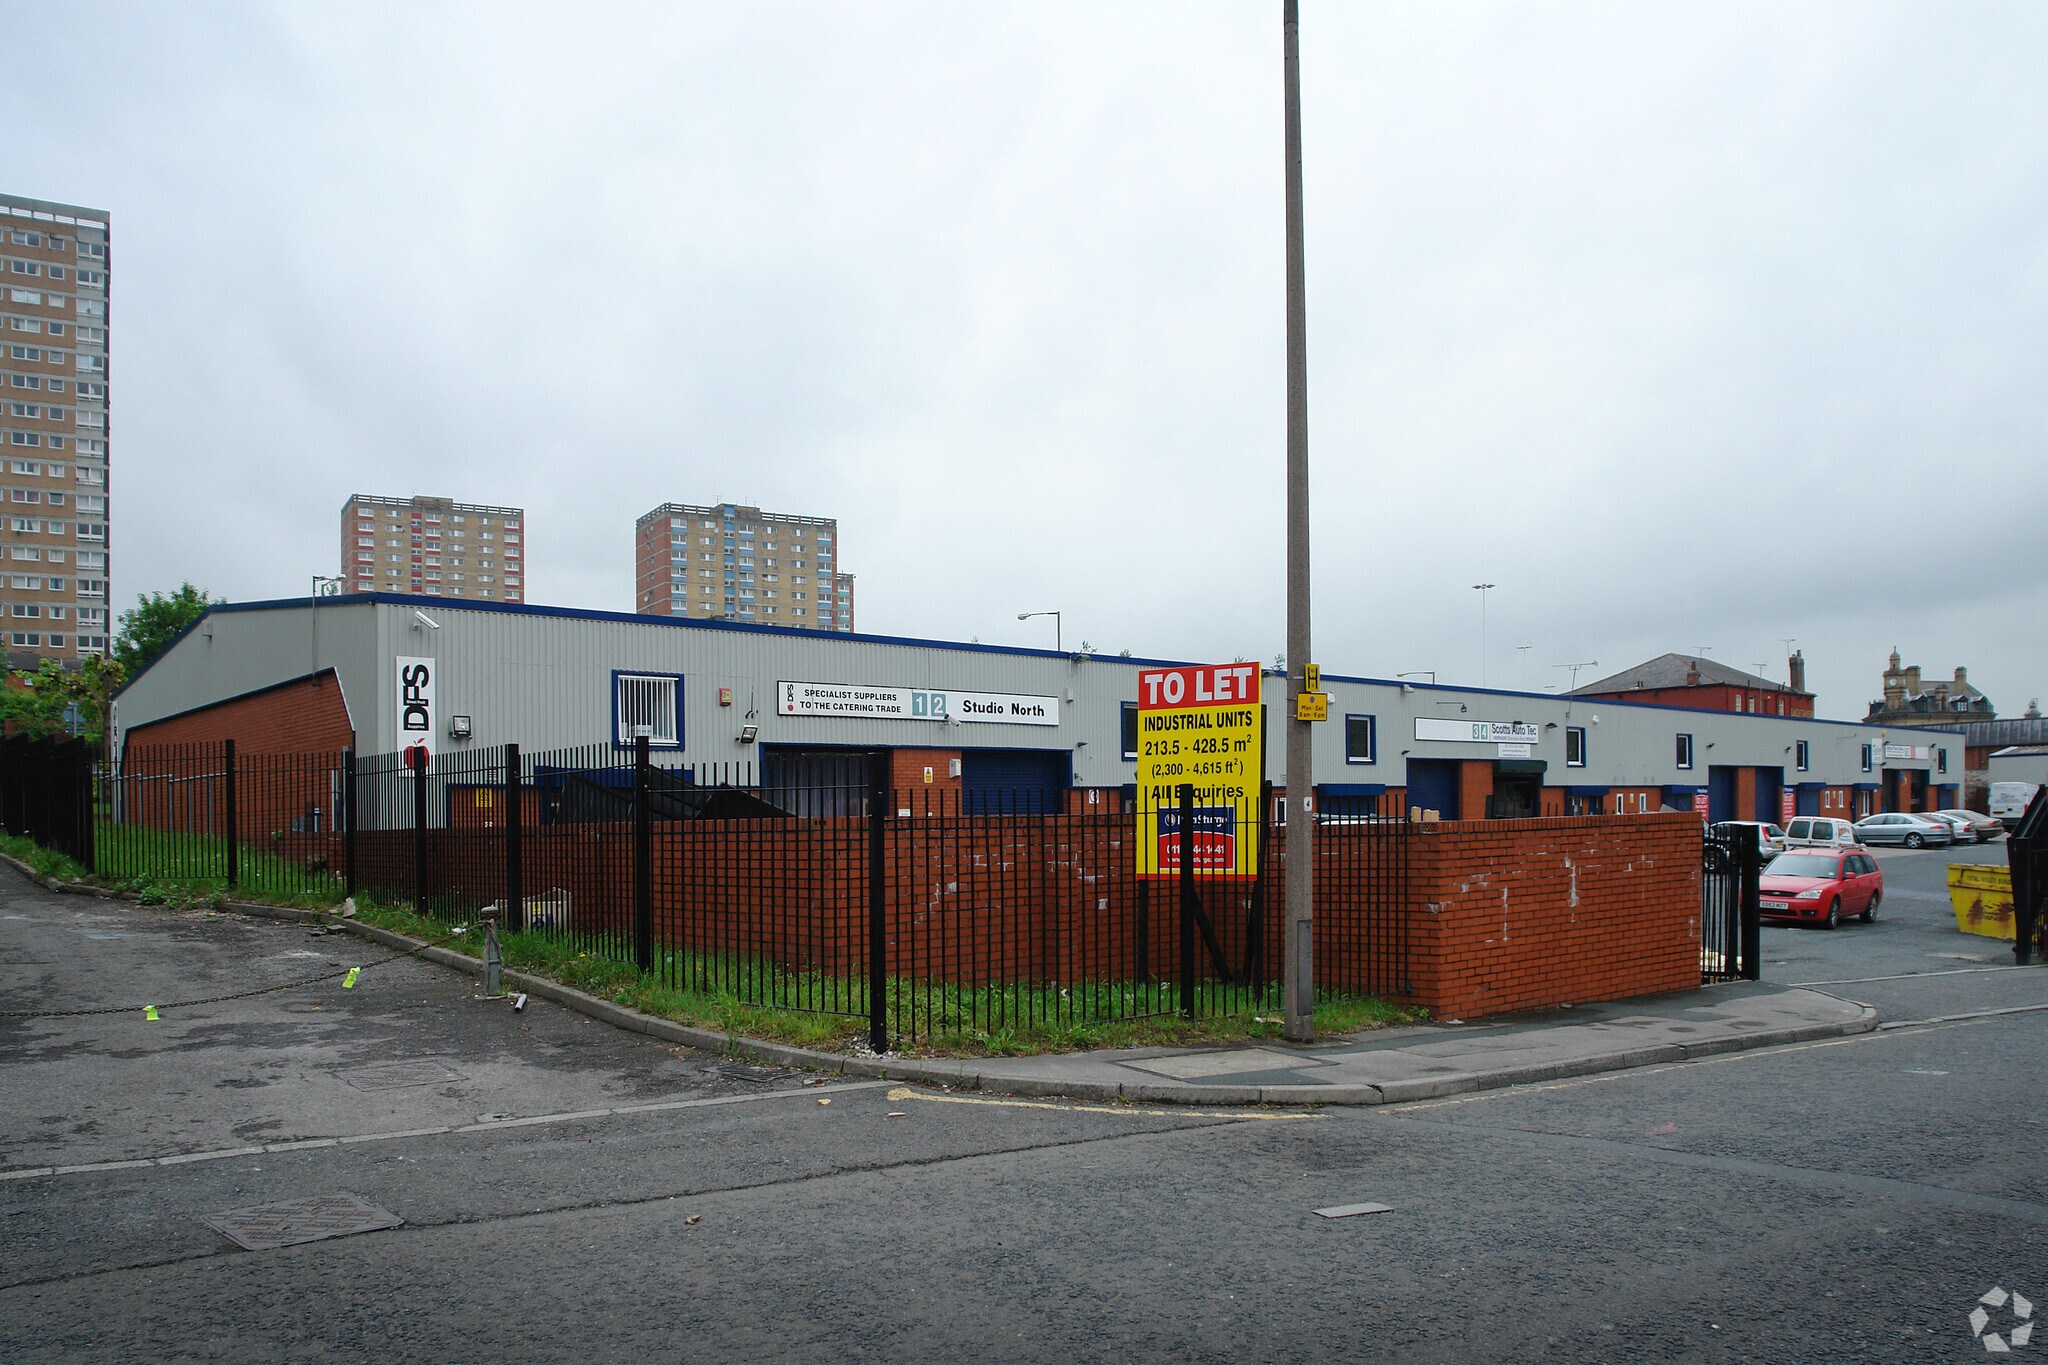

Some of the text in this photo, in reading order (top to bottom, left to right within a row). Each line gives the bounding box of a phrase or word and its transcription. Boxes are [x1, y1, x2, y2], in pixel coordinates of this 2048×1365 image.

[1144, 667, 1253, 705] TO LET
[1308, 667, 1318, 689] H
[402, 664, 429, 731] DFS
[804, 688, 898, 702] SPECIALIST SUPPLIERS
[800, 701, 902, 713] TO THE CATERING TRADE
[915, 696, 944, 714] 1 2
[962, 699, 1045, 717] Studio North
[1144, 710, 1253, 732] INDUSTRIAL UNITS
[1491, 723, 1537, 736] Scotts Auto Tec
[1474, 725, 1479, 738] 3
[1481, 726, 1487, 739] 4
[1145, 740, 1180, 756] 213.5
[1192, 737, 1230, 754] 428.5
[1151, 762, 1183, 779] (2,300
[1193, 761, 1222, 777] 4,615
[1174, 783, 1244, 802] Equiries
